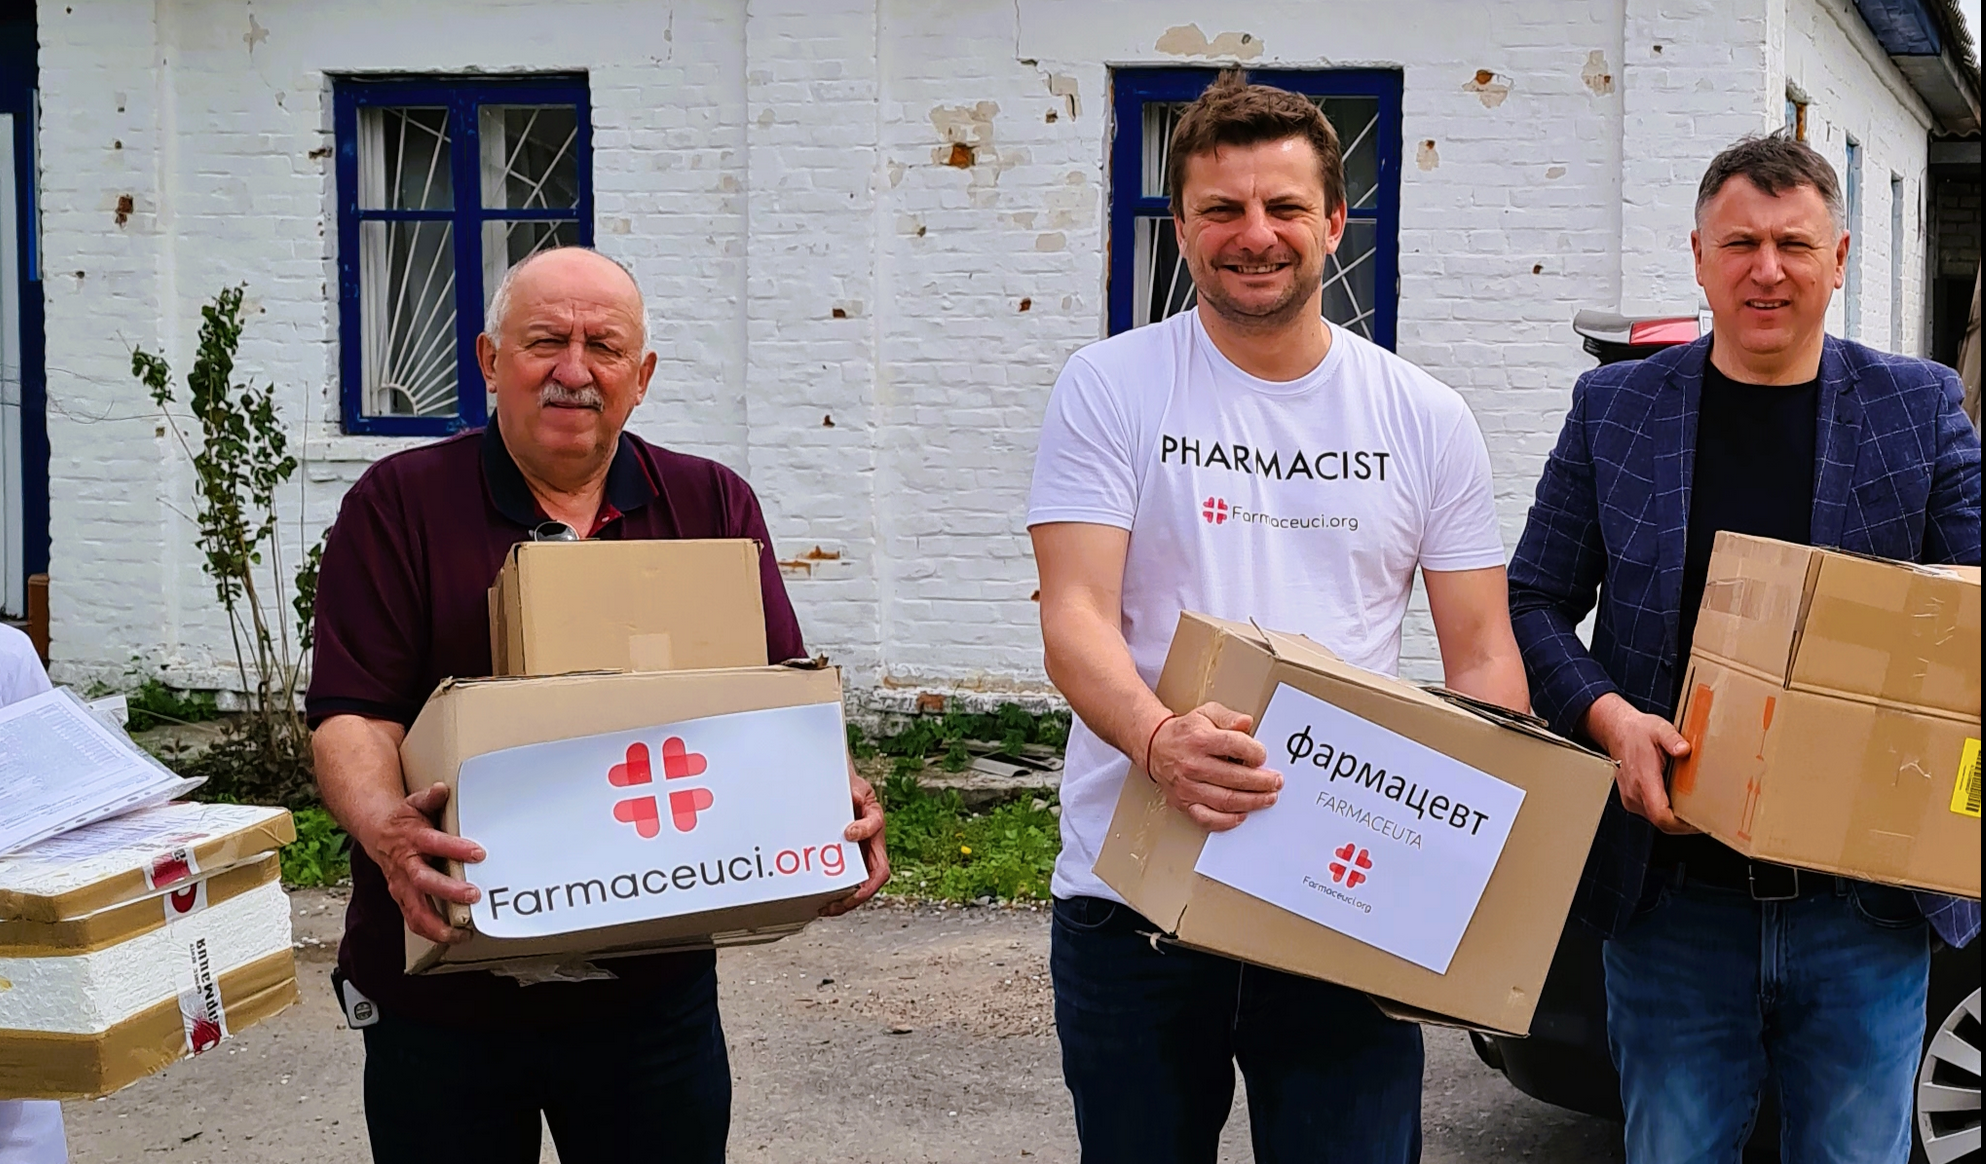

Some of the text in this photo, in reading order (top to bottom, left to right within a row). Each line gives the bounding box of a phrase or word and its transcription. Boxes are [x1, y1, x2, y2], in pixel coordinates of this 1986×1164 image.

[1161, 434, 1390, 481] PHARMACIST
[1232, 505, 1359, 531] Farmaceuci.org
[1285, 724, 1490, 837] фармацевт
[1315, 791, 1422, 850] FARMACEUTA
[488, 841, 846, 920] Farmaceuci.org
[1302, 875, 1372, 913] Farmaceuci.org
